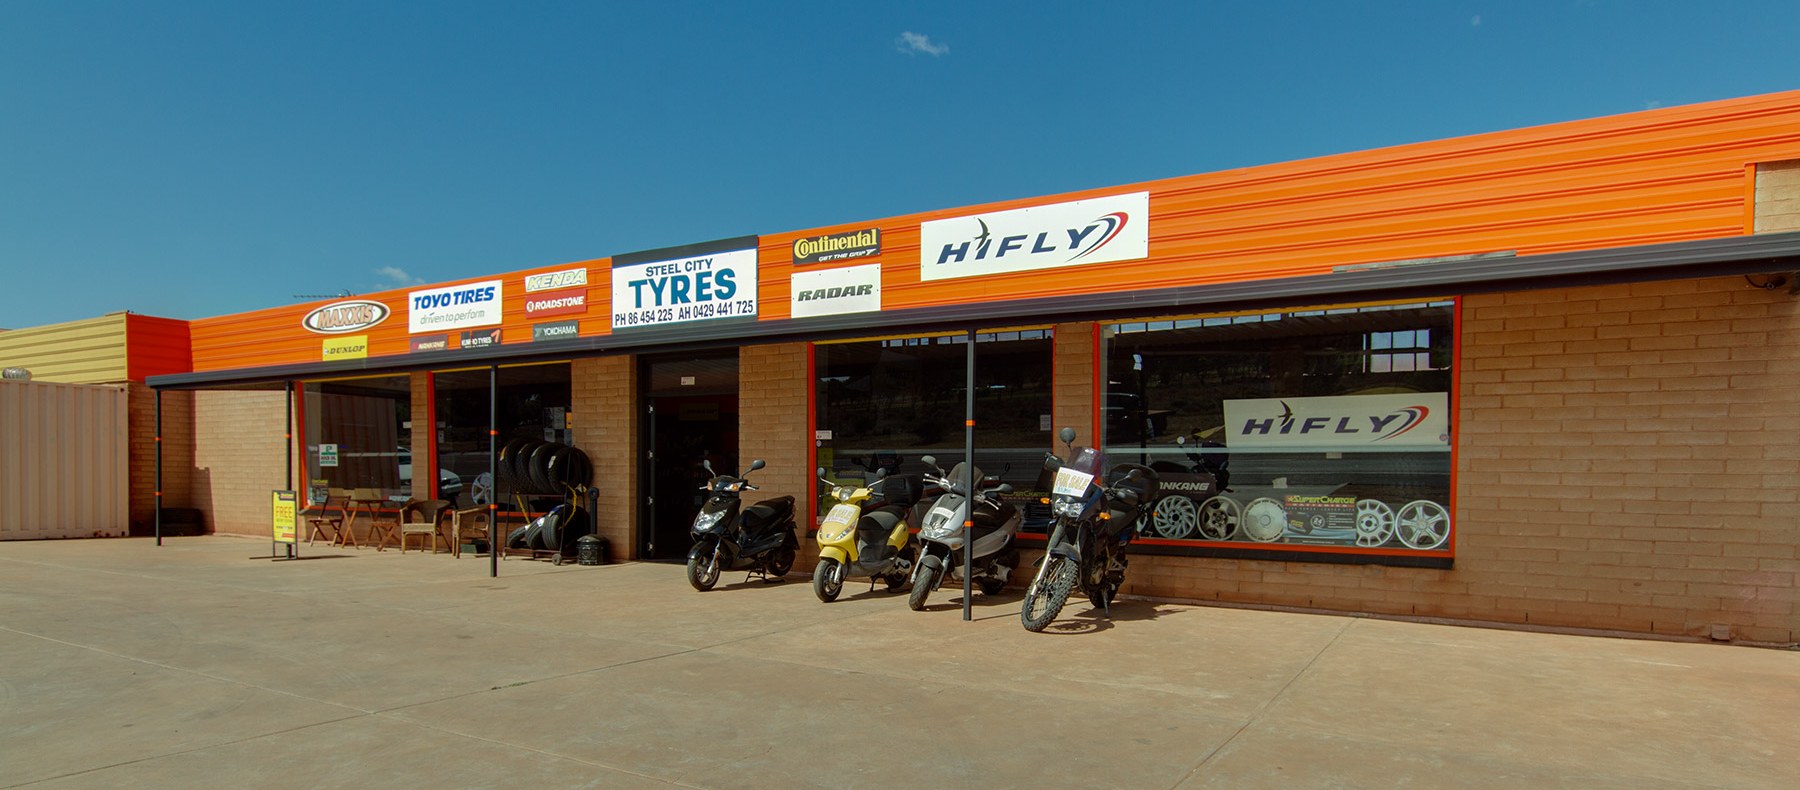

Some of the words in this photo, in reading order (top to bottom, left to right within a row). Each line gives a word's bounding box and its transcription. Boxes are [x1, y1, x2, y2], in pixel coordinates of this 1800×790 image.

[794, 228, 877, 259] Continental
[936, 222, 1100, 265] HIFLY
[646, 263, 682, 277] STEEL
[684, 258, 713, 272] CITY
[527, 269, 586, 291] KENDA
[628, 268, 737, 309] TYRES
[414, 292, 451, 310] TOYO
[453, 286, 496, 306] TIRES
[798, 284, 873, 302] RADAR
[534, 296, 585, 311] ROADSTONE
[614, 313, 626, 326] PH
[628, 311, 639, 325] 86
[640, 310, 656, 324] 454
[657, 308, 673, 322] 225
[678, 306, 691, 320] AH
[693, 303, 714, 319] 0429
[716, 301, 733, 315] 441
[736, 300, 754, 314] 725
[317, 304, 374, 329] MAXXIS
[420, 311, 445, 325] driven
[445, 313, 454, 322] to
[454, 309, 485, 323] perform
[478, 336, 492, 345] TYRES
[543, 325, 577, 336] YOKOHAMA
[329, 345, 366, 355] DUNLOP
[1242, 414, 1400, 435] HIFLY
[1160, 482, 1209, 491] NKANG
